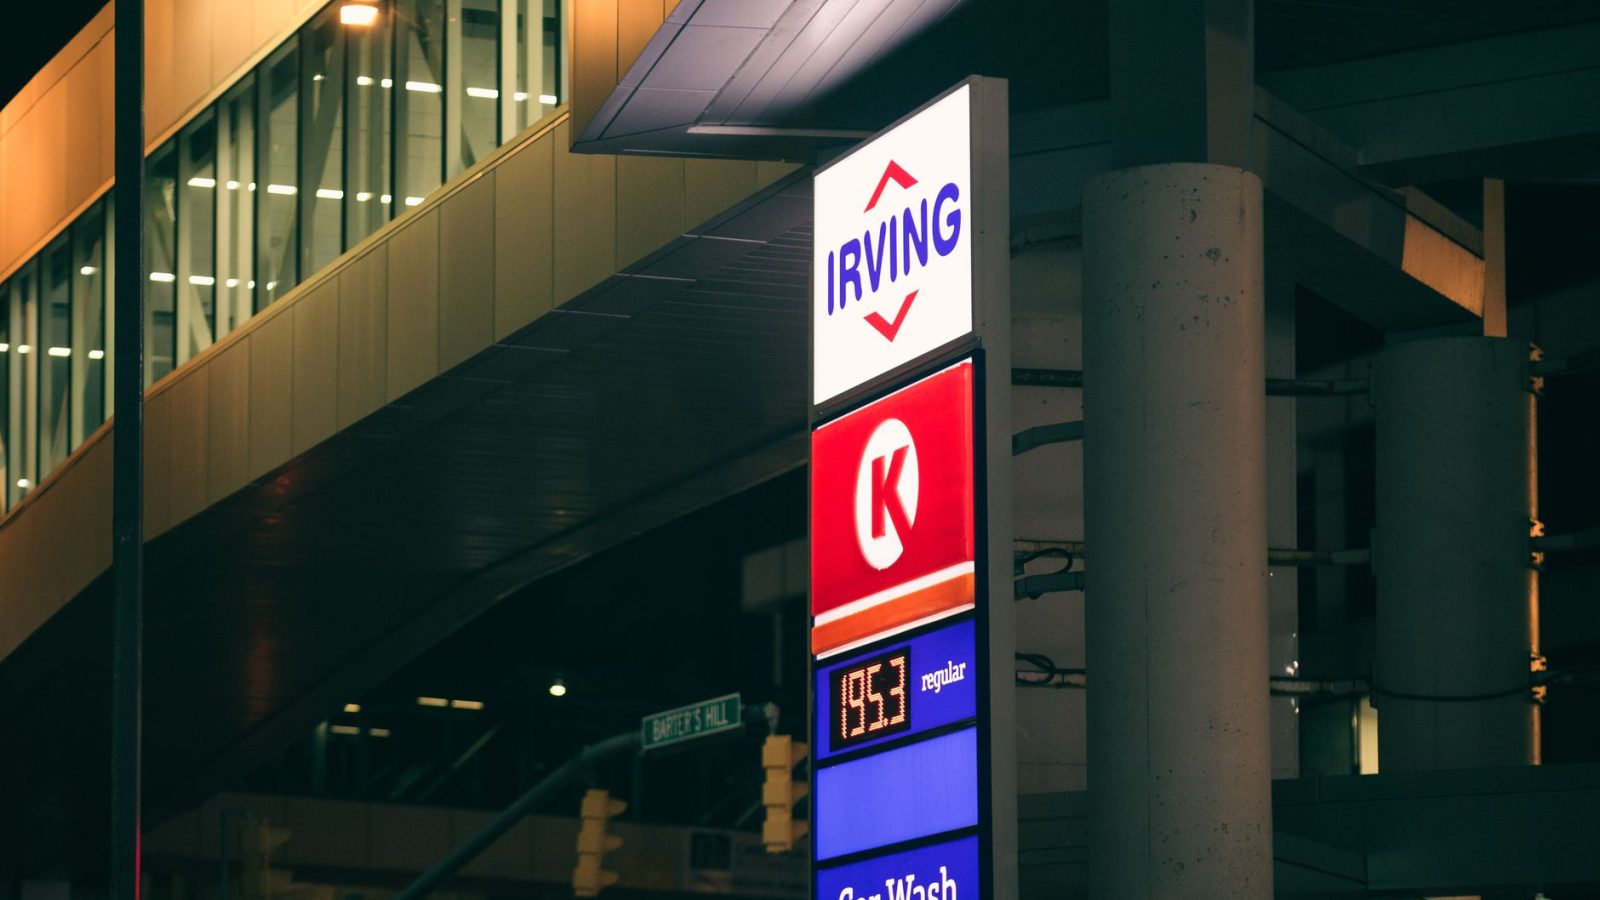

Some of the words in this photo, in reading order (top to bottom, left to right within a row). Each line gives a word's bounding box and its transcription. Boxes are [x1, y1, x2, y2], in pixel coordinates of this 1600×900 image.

[827, 182, 962, 316] IRVING
[652, 708, 702, 743] BARTER'S
[705, 702, 729, 729] HILL
[841, 656, 905, 739] 195.3
[921, 660, 966, 694] regular
